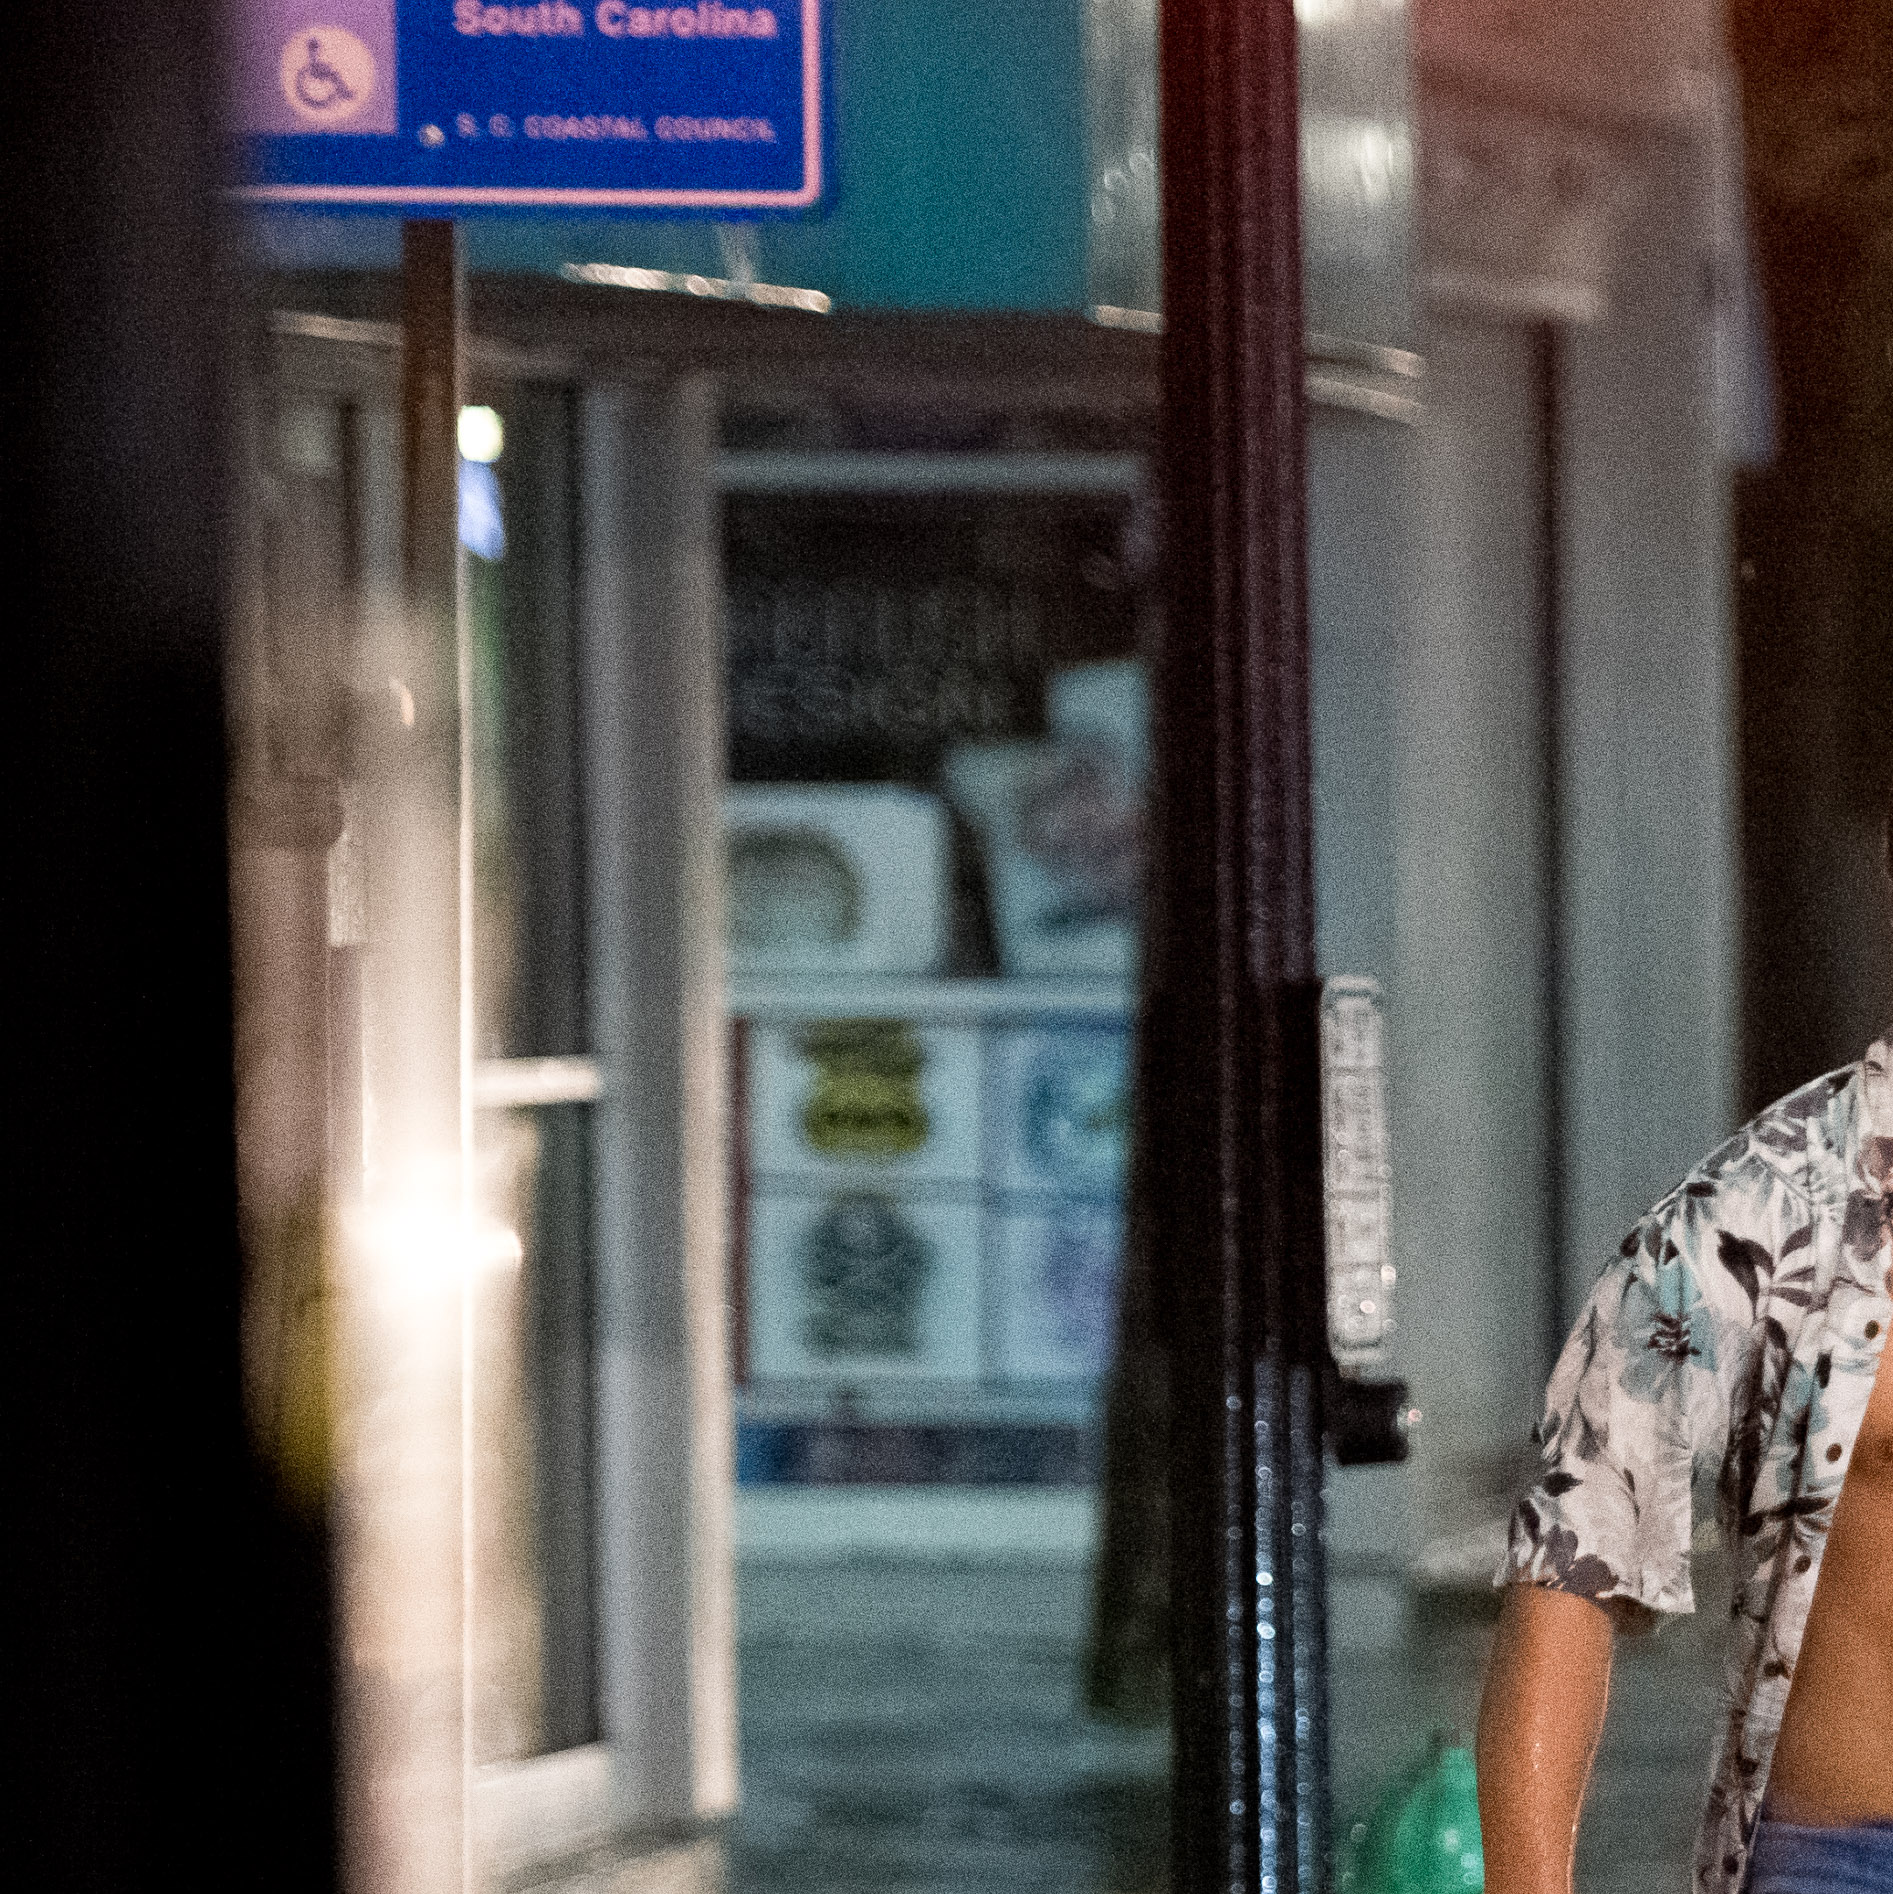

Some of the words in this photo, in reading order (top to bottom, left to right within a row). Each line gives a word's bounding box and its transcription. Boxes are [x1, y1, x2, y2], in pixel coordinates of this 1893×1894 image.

[454, 0, 582, 36] South
[597, 0, 776, 38] Carolina
[525, 114, 647, 141] COASTAL
[656, 115, 776, 143] COUNCIL
